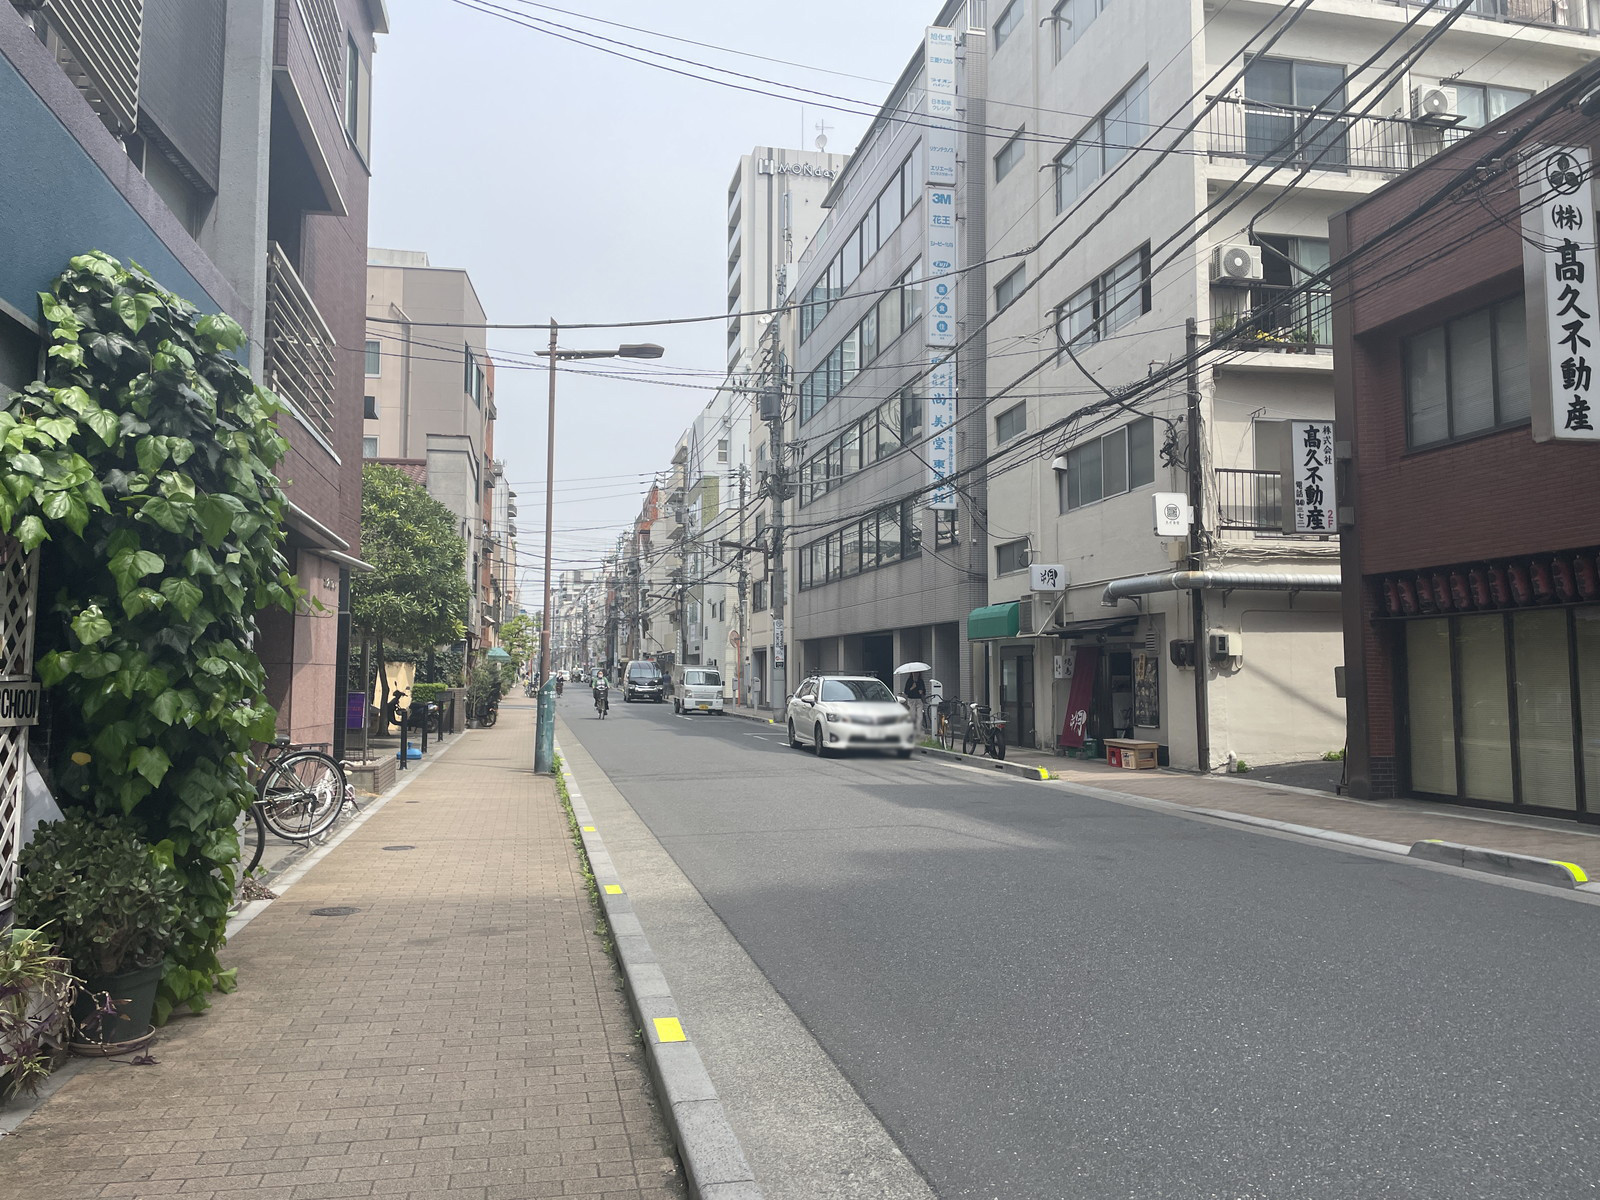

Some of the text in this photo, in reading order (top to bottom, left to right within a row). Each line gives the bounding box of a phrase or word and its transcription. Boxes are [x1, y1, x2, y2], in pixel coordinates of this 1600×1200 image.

[930, 32, 952, 41] 旭化成
[932, 193, 951, 205] 3M
[932, 215, 951, 225] 花王
[1322, 425, 1332, 465] 株式会社
[1327, 509, 1333, 528] 2F
